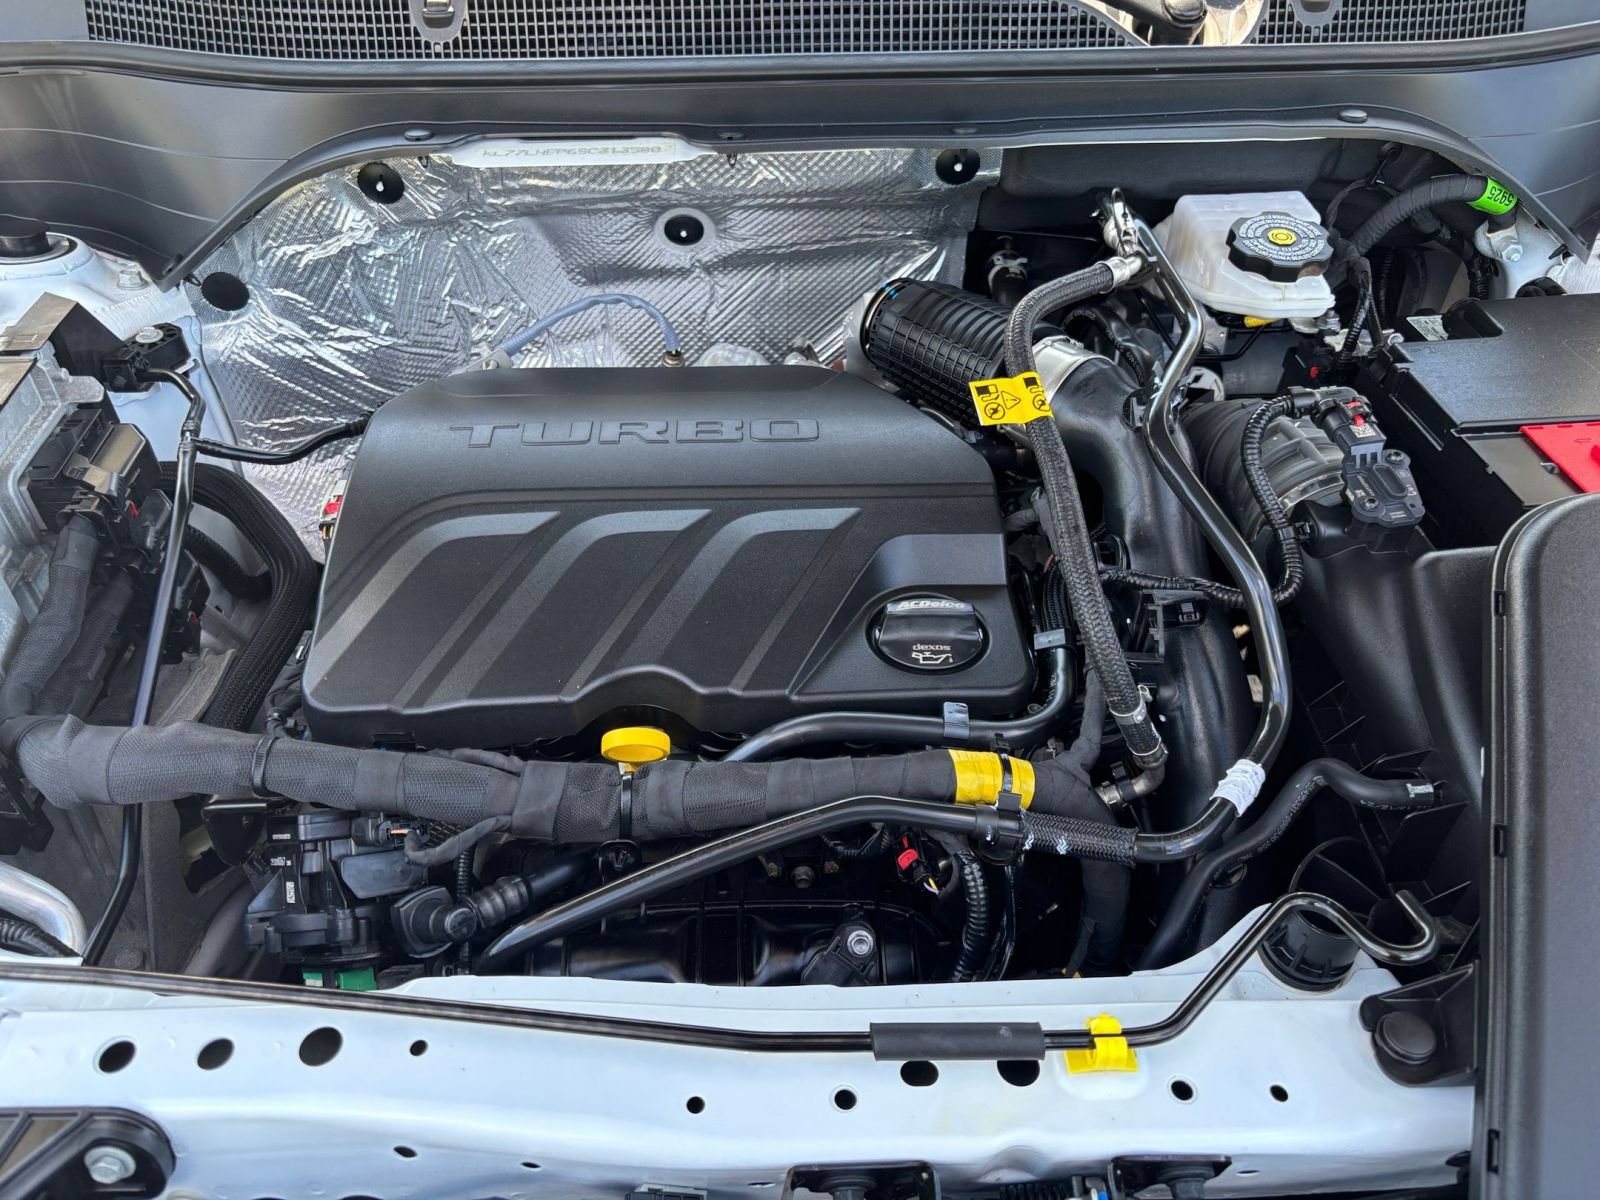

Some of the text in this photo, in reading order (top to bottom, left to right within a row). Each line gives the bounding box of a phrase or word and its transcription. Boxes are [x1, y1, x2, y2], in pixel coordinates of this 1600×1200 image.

[1487, 185, 1514, 206] 5925
[449, 418, 820, 449] TURBO
[896, 600, 966, 610] ACDelco
[912, 643, 952, 651] dexos
